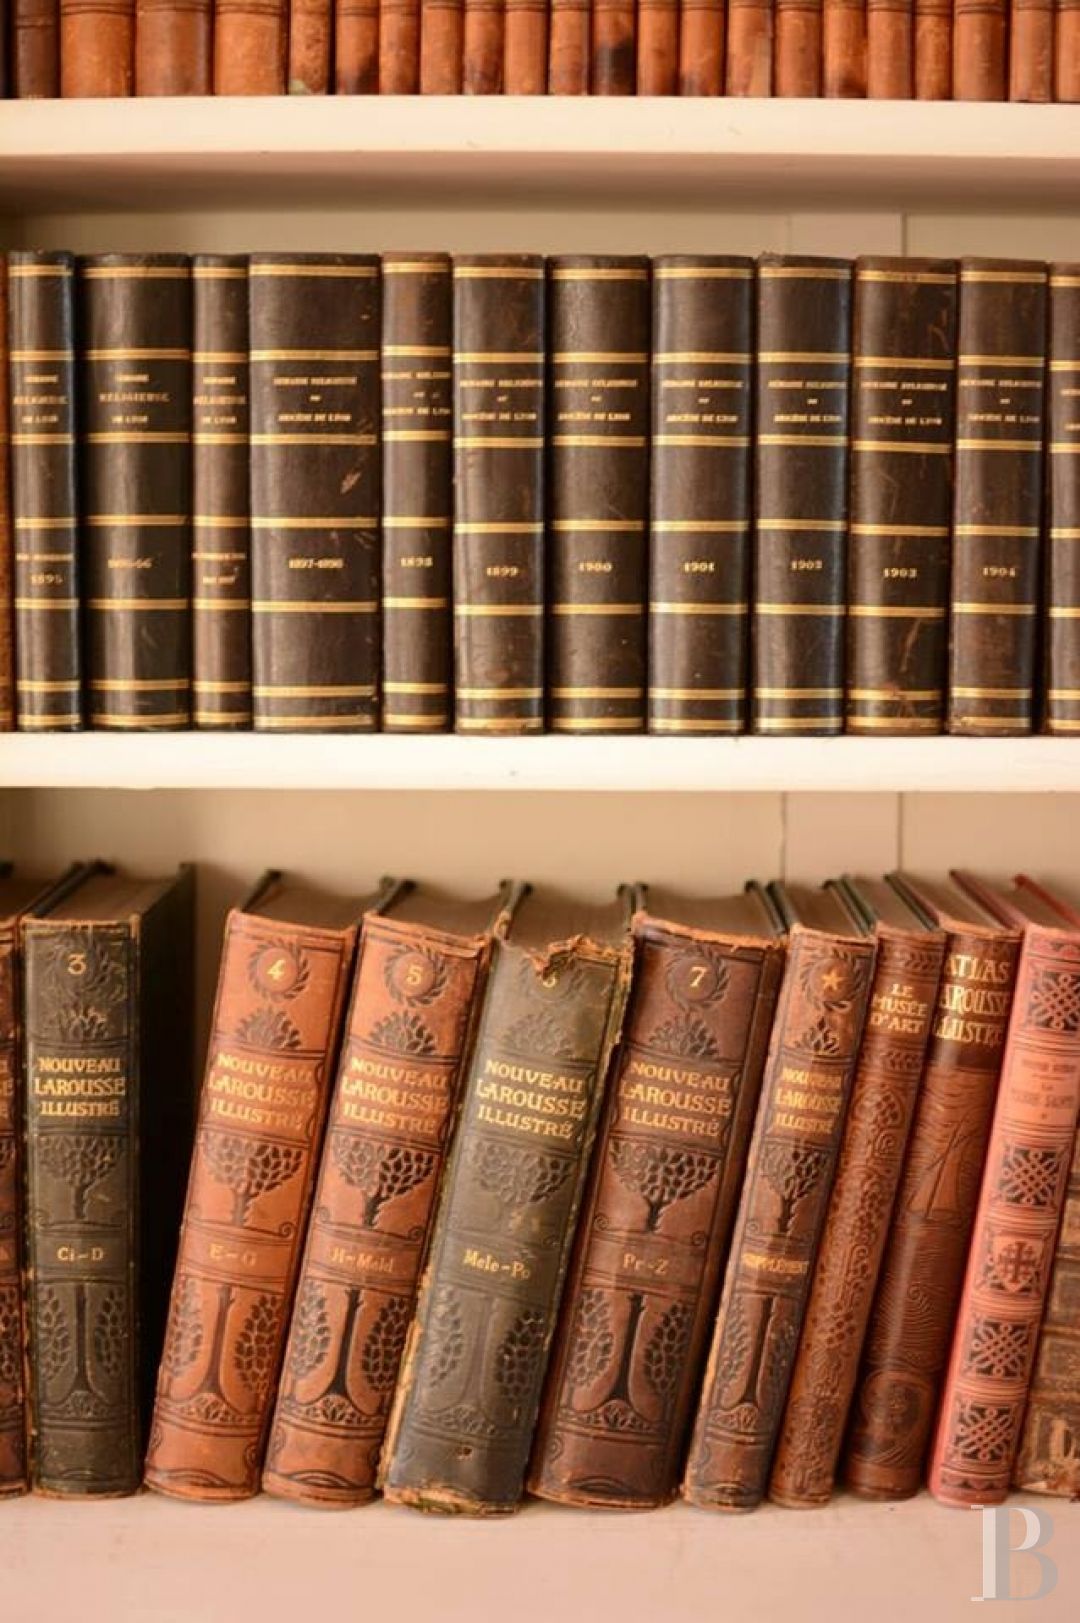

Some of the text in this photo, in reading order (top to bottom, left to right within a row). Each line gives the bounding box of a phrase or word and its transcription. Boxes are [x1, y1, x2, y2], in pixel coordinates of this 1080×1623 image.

[684, 561, 715, 573] 1901
[68, 953, 87, 975] 3
[266, 958, 286, 980] 4
[405, 965, 424, 985] 5
[690, 965, 707, 988] 7
[888, 983, 913, 998] LE
[37, 1056, 121, 1073] NOUVEAU
[216, 1053, 313, 1084] NOUVEAU
[351, 1056, 449, 1090] NOUVEAU
[484, 1059, 584, 1093] NOUVEAU
[631, 1060, 731, 1092] NOUVEAU
[34, 1076, 127, 1096] LAROUSSE
[207, 1071, 317, 1106] LAROUSSE
[342, 1075, 449, 1113] LAROUSSE
[475, 1078, 586, 1120] LAROUSSE
[620, 1080, 733, 1117] LAROUSSE
